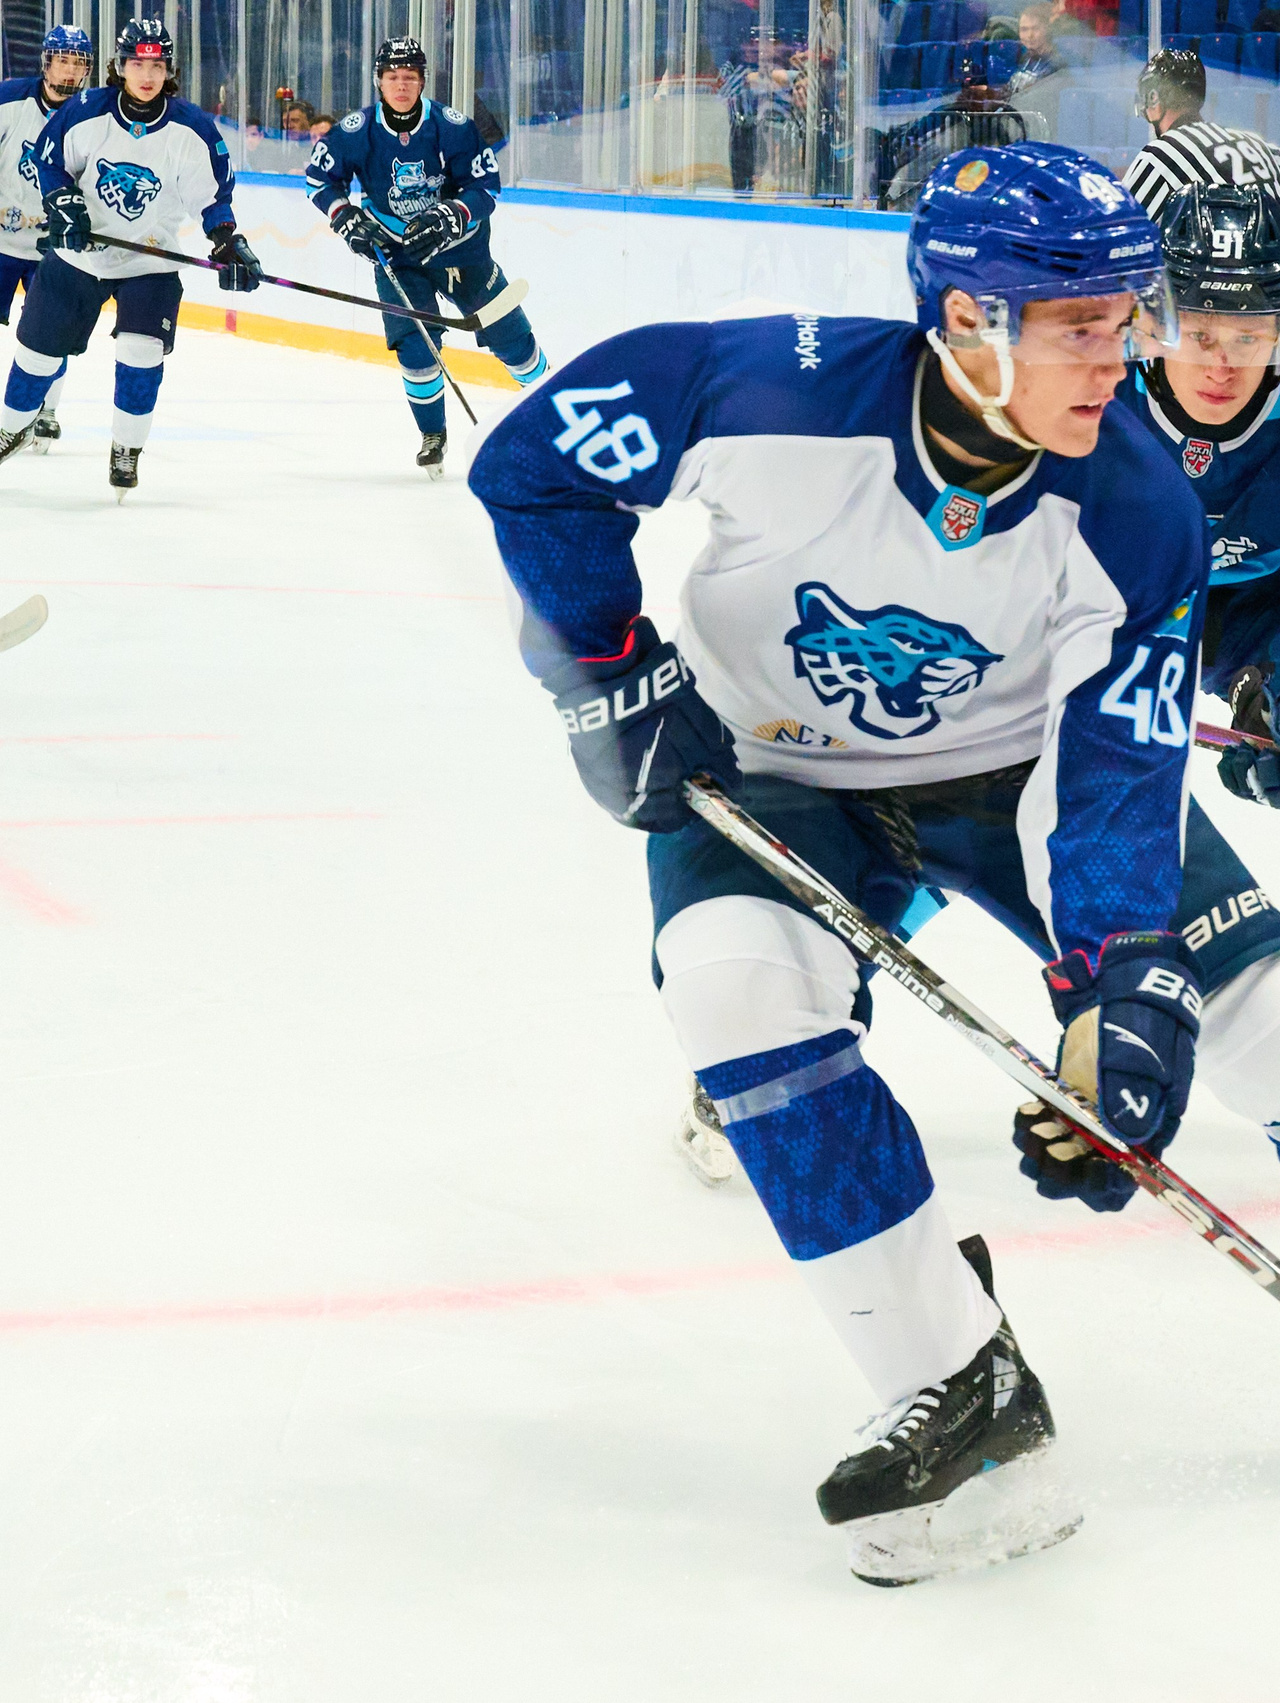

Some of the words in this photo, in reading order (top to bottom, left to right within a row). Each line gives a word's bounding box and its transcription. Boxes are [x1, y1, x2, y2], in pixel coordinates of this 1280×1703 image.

[311, 141, 335, 172] 83
[471, 148, 499, 178] 83
[1214, 140, 1271, 186] 29
[56, 194, 84, 206] CC
[338, 212, 362, 238] CM
[438, 204, 459, 236] CM
[926, 239, 978, 258] BAUER
[1109, 242, 1154, 260] BAUER
[1211, 230, 1243, 260] 91
[1200, 281, 1253, 292] BAUER
[794, 321, 822, 370] Halyk
[551, 381, 660, 482] 48
[1188, 445, 1210, 456] МХЛ
[949, 500, 976, 519] МХЛ
[1099, 646, 1188, 748] 48
[1181, 888, 1272, 952] AUER
[812, 903, 874, 953] ACE
[873, 950, 944, 1012] prime
